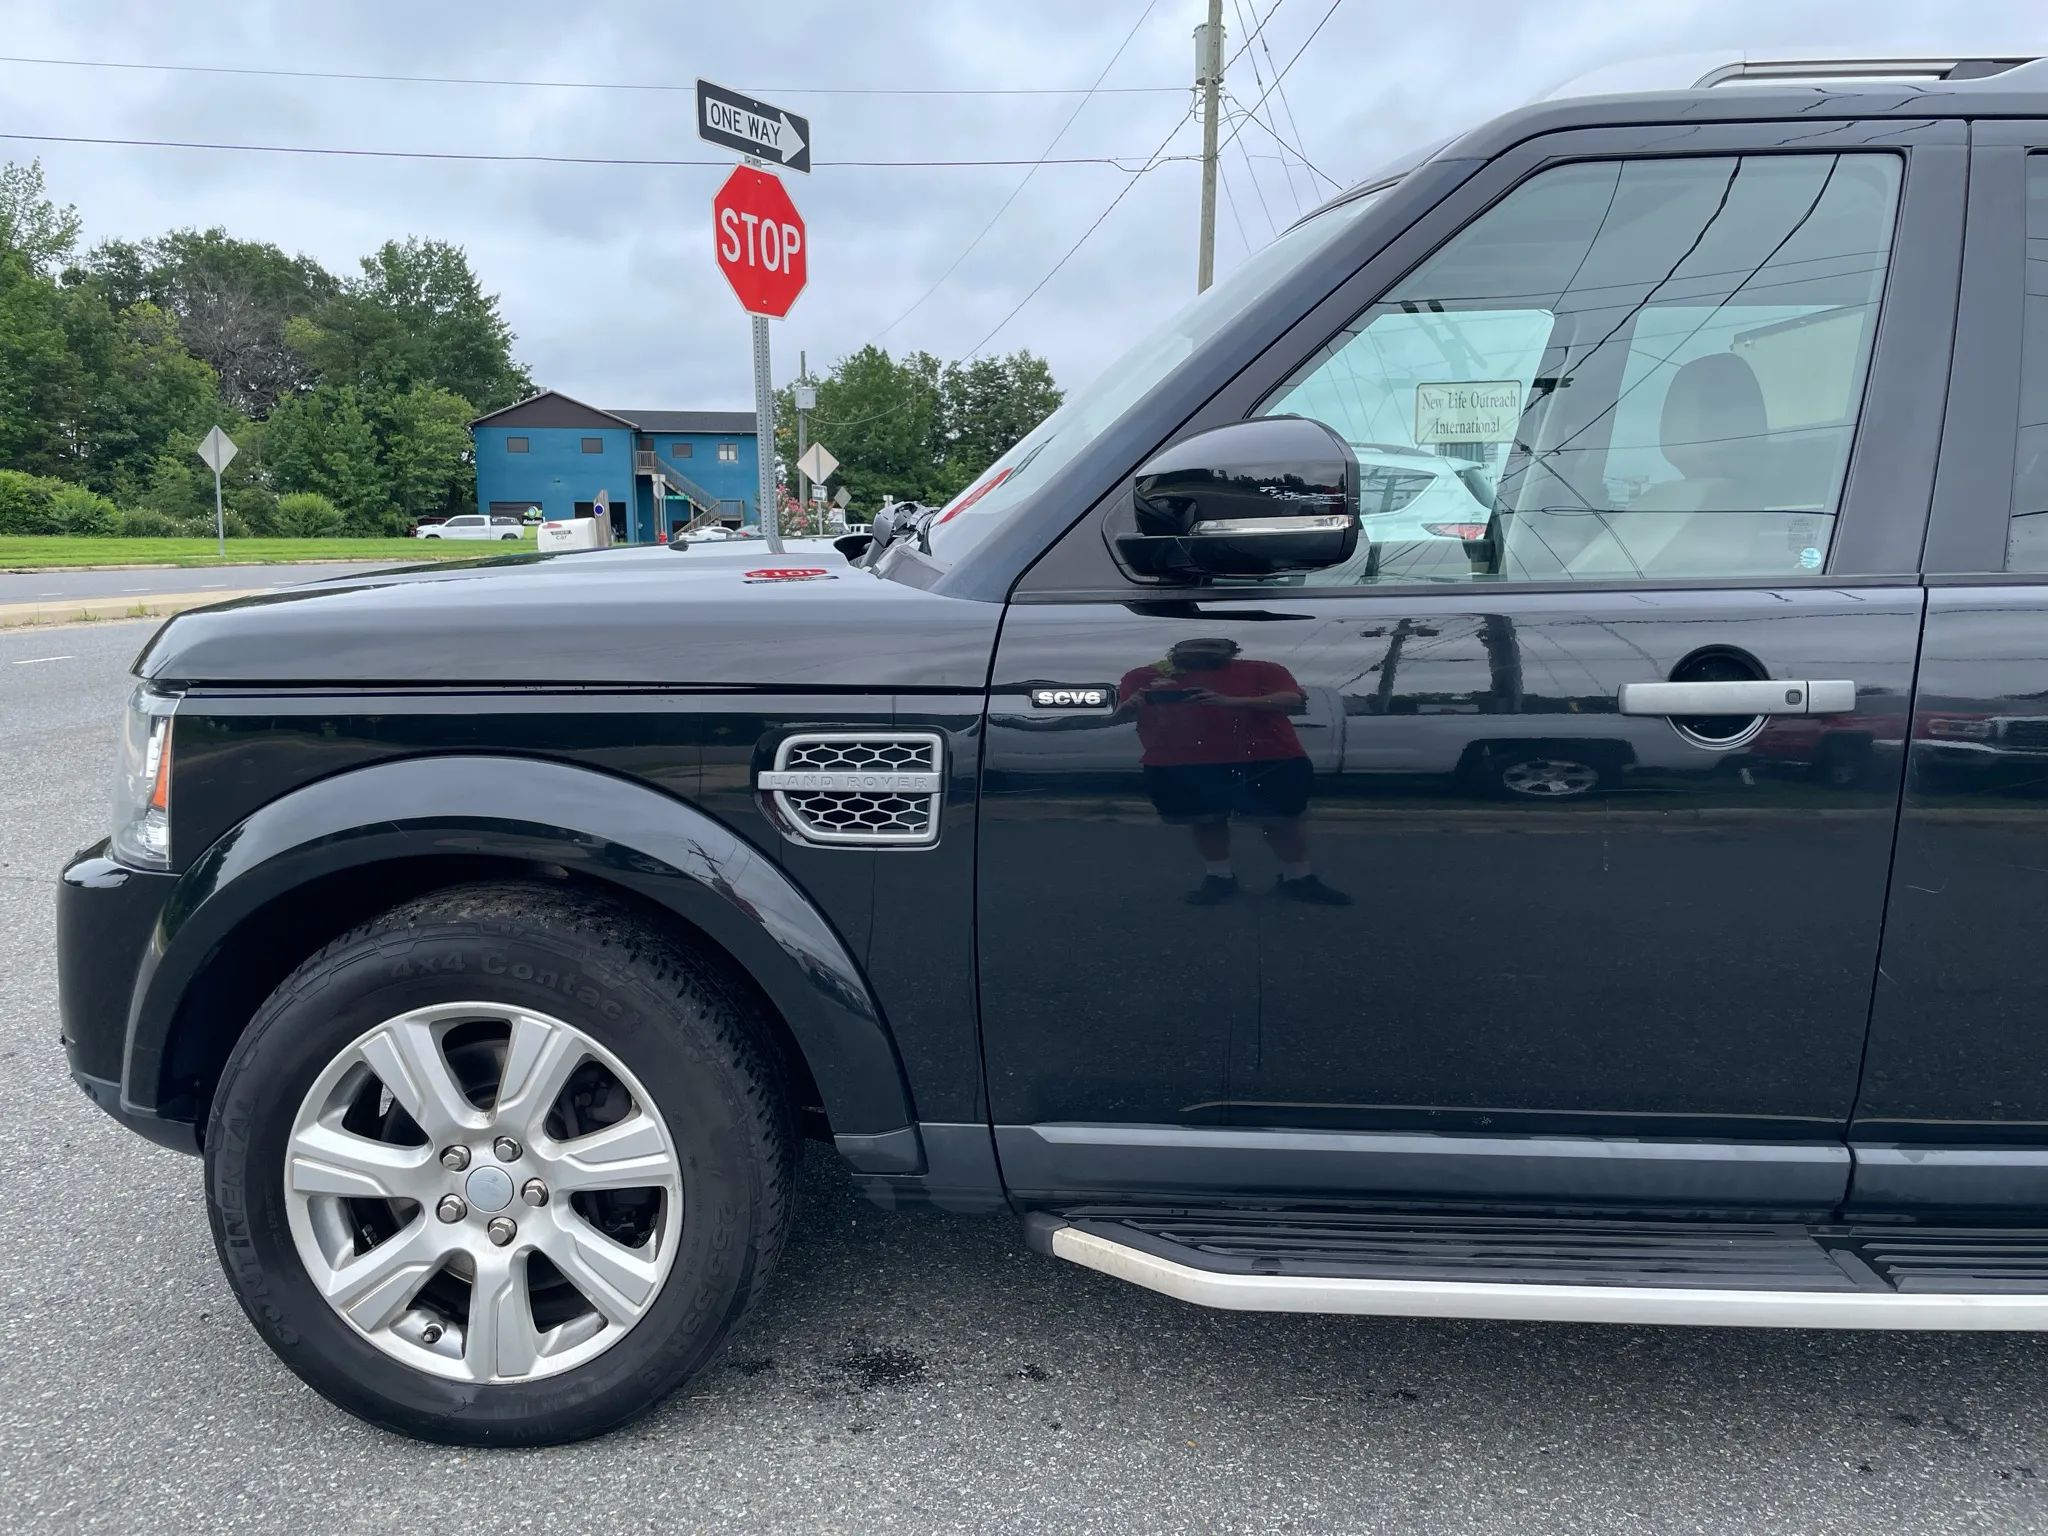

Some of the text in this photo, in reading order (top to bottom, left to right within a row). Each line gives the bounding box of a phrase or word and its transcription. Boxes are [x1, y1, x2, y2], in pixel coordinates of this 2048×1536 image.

[710, 103, 781, 146] ONE WAY
[720, 207, 801, 275] STOP
[1422, 390, 1517, 410] New Life Outreach
[1435, 416, 1500, 434] International
[1038, 691, 1101, 705] SCV6
[770, 775, 928, 789] LAND ROVER
